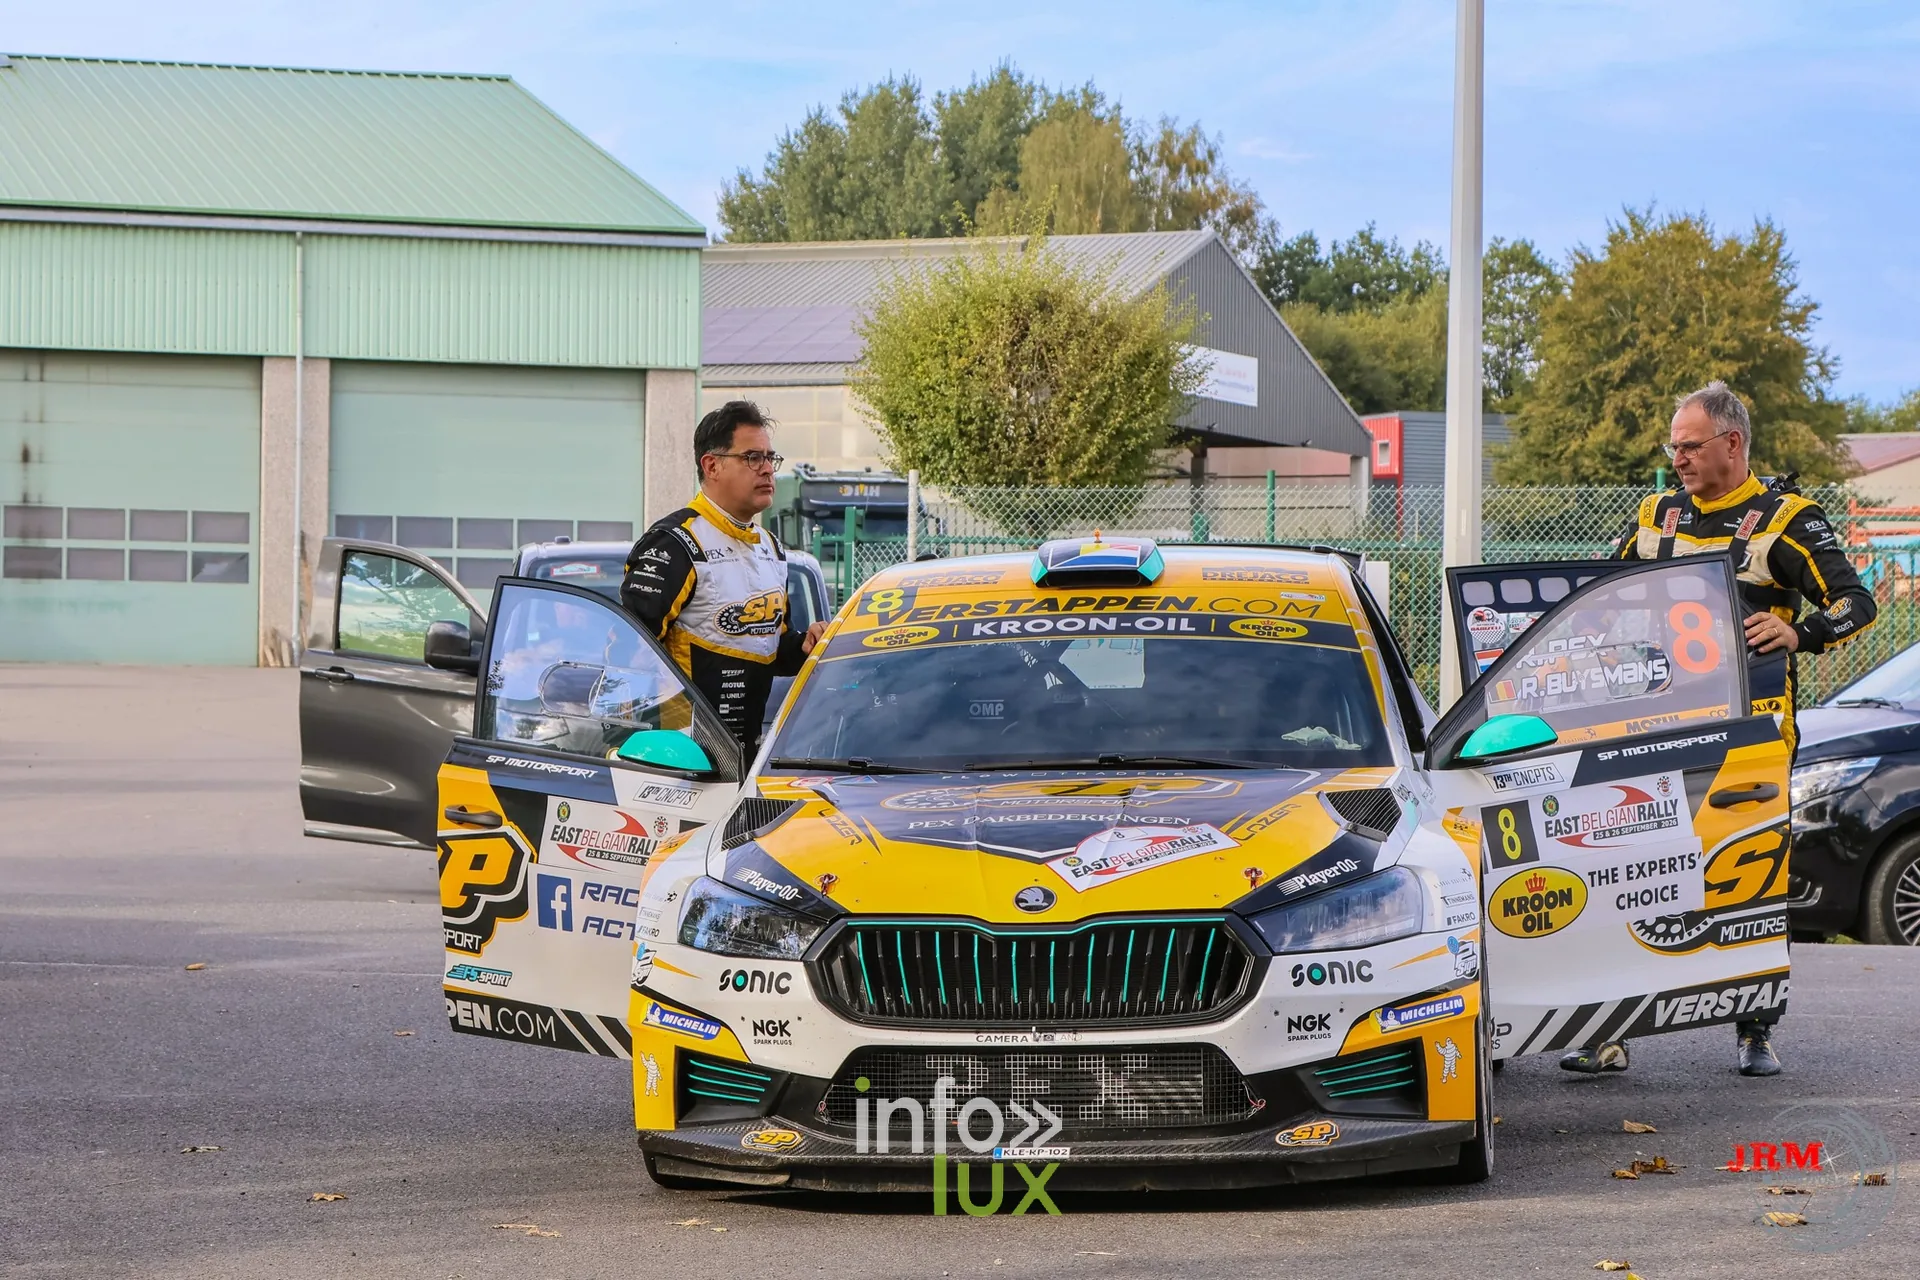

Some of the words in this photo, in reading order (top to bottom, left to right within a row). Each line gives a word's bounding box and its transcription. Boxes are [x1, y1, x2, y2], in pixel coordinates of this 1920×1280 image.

[1666, 510, 1677, 535] SIMPSON
[1739, 512, 1758, 537] SIMPSON
[1202, 571, 1309, 581] DREJACO
[738, 591, 783, 623] SP
[867, 589, 905, 613] 8
[877, 596, 1321, 626] VERSTAPPEN.COM
[873, 631, 929, 643] KROON
[972, 617, 1197, 637] KROON-OIL
[1240, 623, 1297, 633] KROON
[1669, 601, 1721, 674] 8
[887, 637, 911, 646] OIL
[969, 702, 1005, 716] OMP
[1596, 751, 1620, 762] SP
[1621, 731, 1729, 758] MOTORSPORT
[485, 754, 507, 764] SP
[504, 757, 599, 779] MOTORSPORT
[1491, 773, 1513, 790] 13TH
[1512, 766, 1556, 787] CNCPTS
[638, 784, 661, 799] 13TH
[656, 788, 698, 806] CNCPTS
[907, 819, 956, 830] PEX
[962, 812, 1192, 827] DAKBEDEKKINGEN
[1595, 830, 1604, 840] 25
[1612, 828, 1621, 837] 26
[1621, 822, 1658, 835] SEPTEMBER
[1114, 831, 1125, 840] 8
[1496, 807, 1523, 861] 8
[587, 849, 596, 857] 25
[601, 852, 609, 860] 26
[609, 854, 642, 865] SEPTEMBER
[1157, 844, 1199, 858] SEPTEMBER
[437, 837, 515, 909] P
[743, 868, 782, 895] Player
[1294, 865, 1342, 890] Player
[1588, 867, 1619, 888] THE
[1502, 887, 1573, 918] KROON
[1616, 884, 1679, 911] CHOICE
[1452, 911, 1476, 925] FAKRO
[1522, 912, 1554, 934] OIL
[443, 928, 483, 950] PORT
[718, 968, 793, 995] SONIC
[1291, 959, 1374, 988] SONIC
[1400, 998, 1463, 1023] MICHELIN
[661, 1013, 720, 1037] MICHELIN
[752, 1019, 792, 1038] NGK
[1287, 1012, 1332, 1034] NGK
[975, 1035, 1029, 1043] CAMERA
[1287, 1034, 1310, 1042] SPARK
[752, 1131, 797, 1145] SP
[1290, 1123, 1332, 1140] SP
